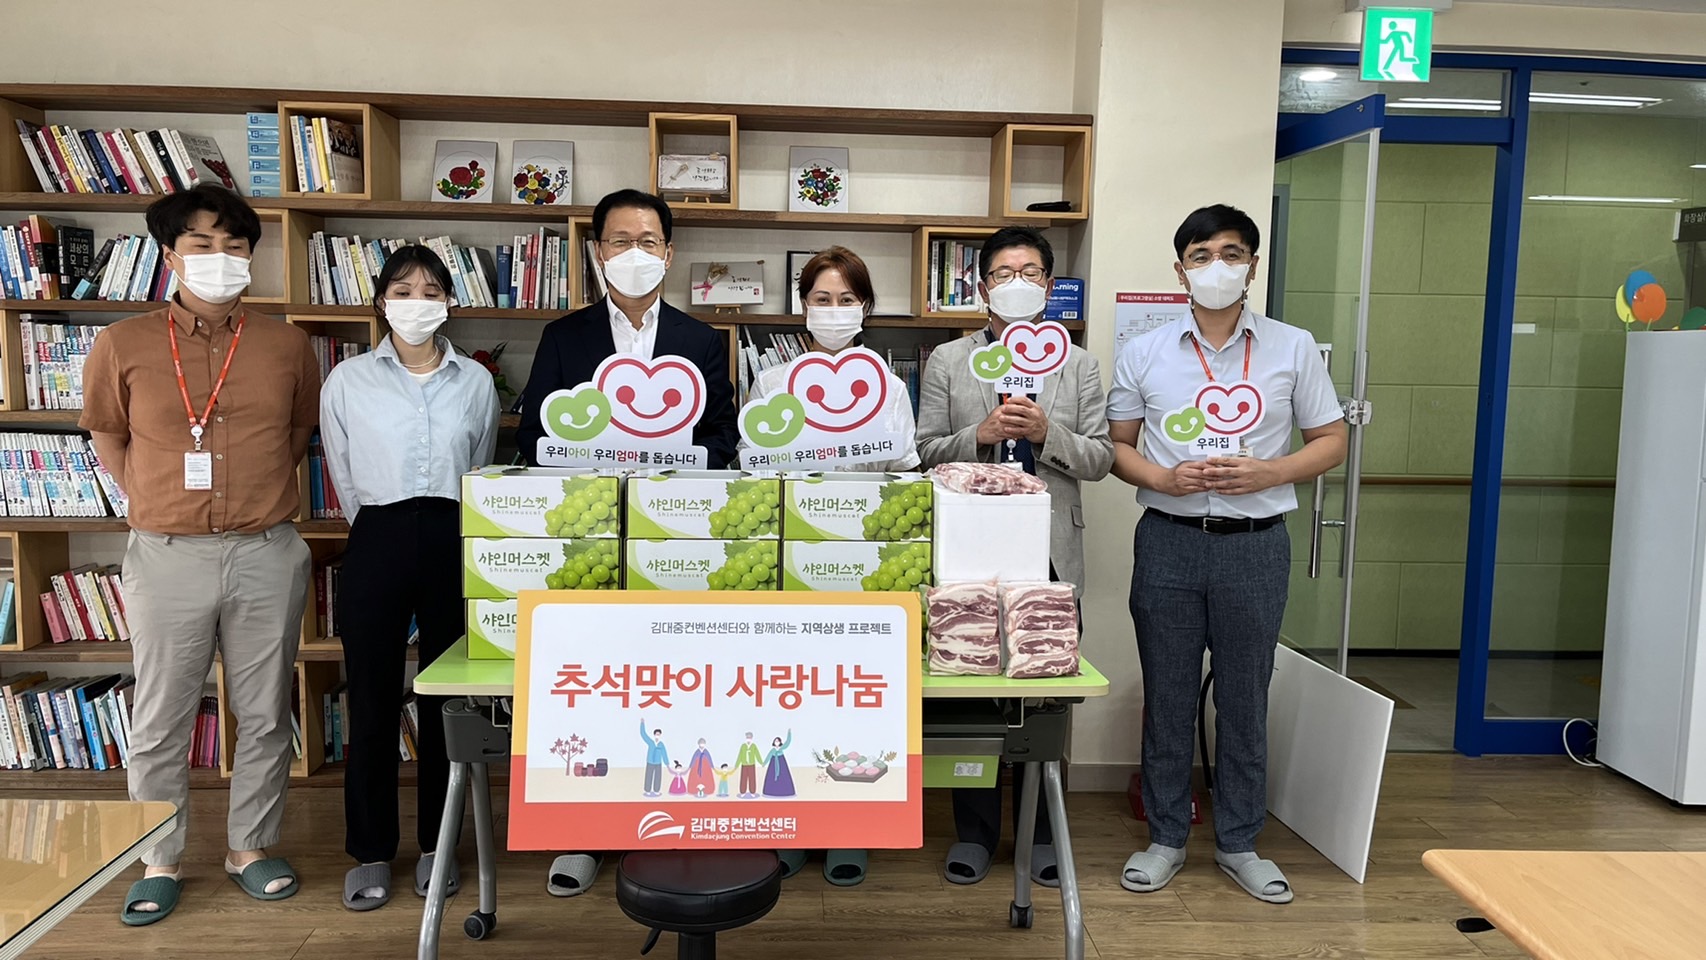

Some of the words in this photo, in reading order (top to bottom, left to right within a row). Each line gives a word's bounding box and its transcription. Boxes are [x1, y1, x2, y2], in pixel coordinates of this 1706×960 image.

[1002, 376, 1034, 389] 우리집
[1196, 437, 1230, 449] 우리집
[546, 445, 590, 459] 우리아이
[593, 449, 650, 463] 우리엄마를
[653, 452, 697, 465] 돕습니다
[749, 452, 791, 468] 우리아이
[794, 445, 848, 462] 우리엄마를
[850, 440, 893, 456] 돕습니다
[482, 496, 548, 509] 샤인머스켓
[648, 498, 712, 511] 샤인머스켓
[799, 497, 867, 512] 샤인머스켓
[479, 552, 550, 567] 샤인머스켓
[646, 559, 710, 572] 샤인머스켓
[803, 563, 866, 576] 샤인머스켓
[651, 621, 750, 635] 김대중컨벤션센터와
[754, 621, 797, 635] 함께하는
[801, 622, 845, 635] 지역상생
[848, 622, 892, 635] 프로젝트
[550, 663, 713, 709] 추석맞이
[726, 663, 888, 710] 사랑나눔
[690, 817, 797, 833] 김대중컨벤션센터
[691, 833, 730, 841] Kimdaejung
